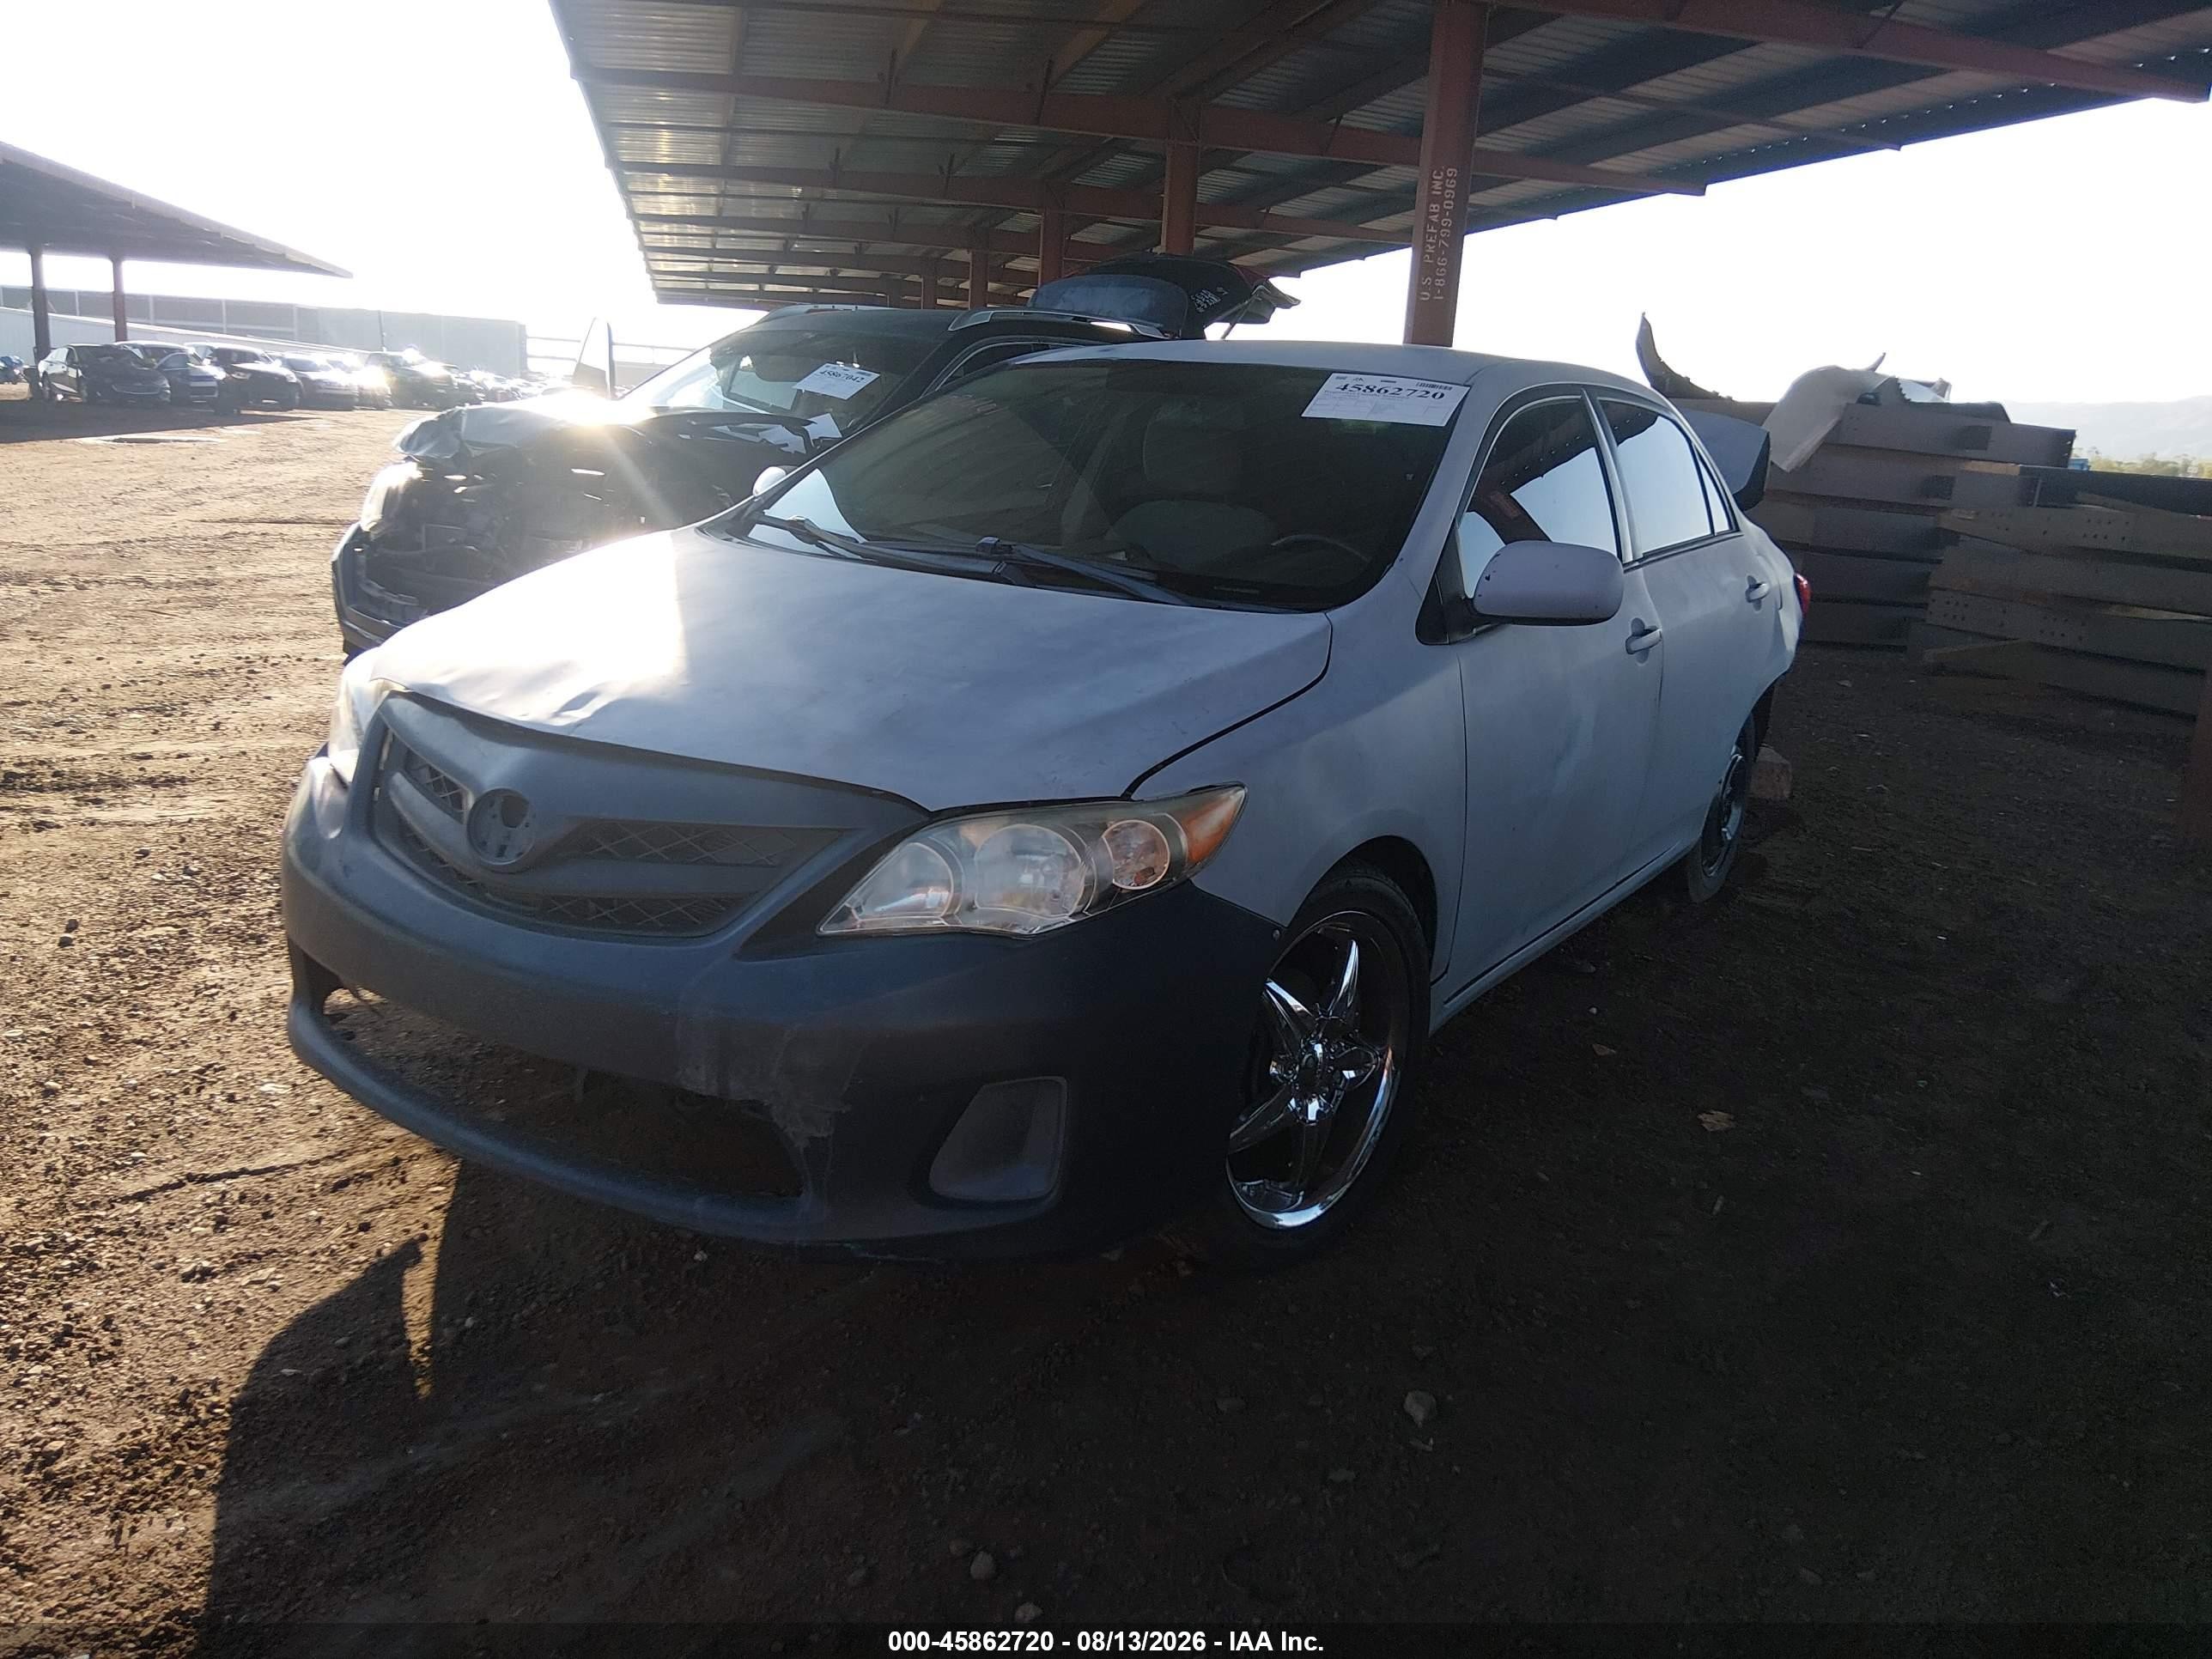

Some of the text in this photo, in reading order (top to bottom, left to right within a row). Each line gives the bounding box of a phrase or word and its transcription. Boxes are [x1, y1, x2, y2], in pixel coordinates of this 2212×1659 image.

[1424, 204, 1440, 263] PREFAB
[1433, 167, 1457, 301] 1-866-799-0969
[1335, 383, 1445, 400] 45862720
